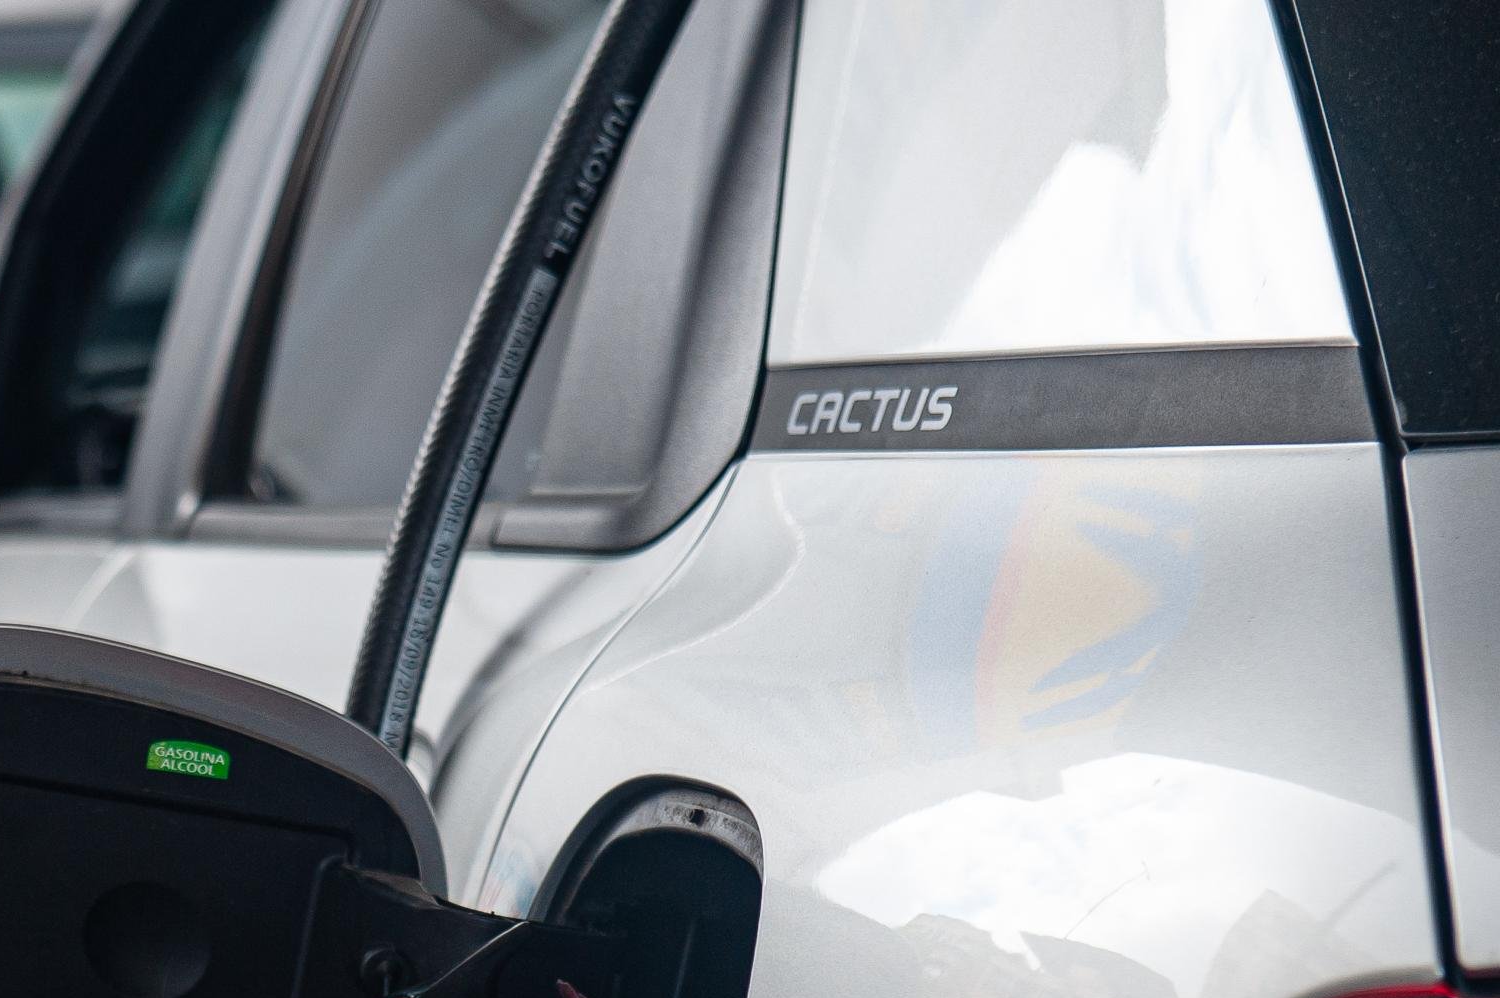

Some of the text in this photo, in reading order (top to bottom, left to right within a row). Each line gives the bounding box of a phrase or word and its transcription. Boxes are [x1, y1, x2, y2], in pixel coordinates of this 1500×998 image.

[787, 387, 958, 435] CACTUS
[155, 746, 225, 764] GASOLINA
[160, 759, 215, 776] ALCOOL
